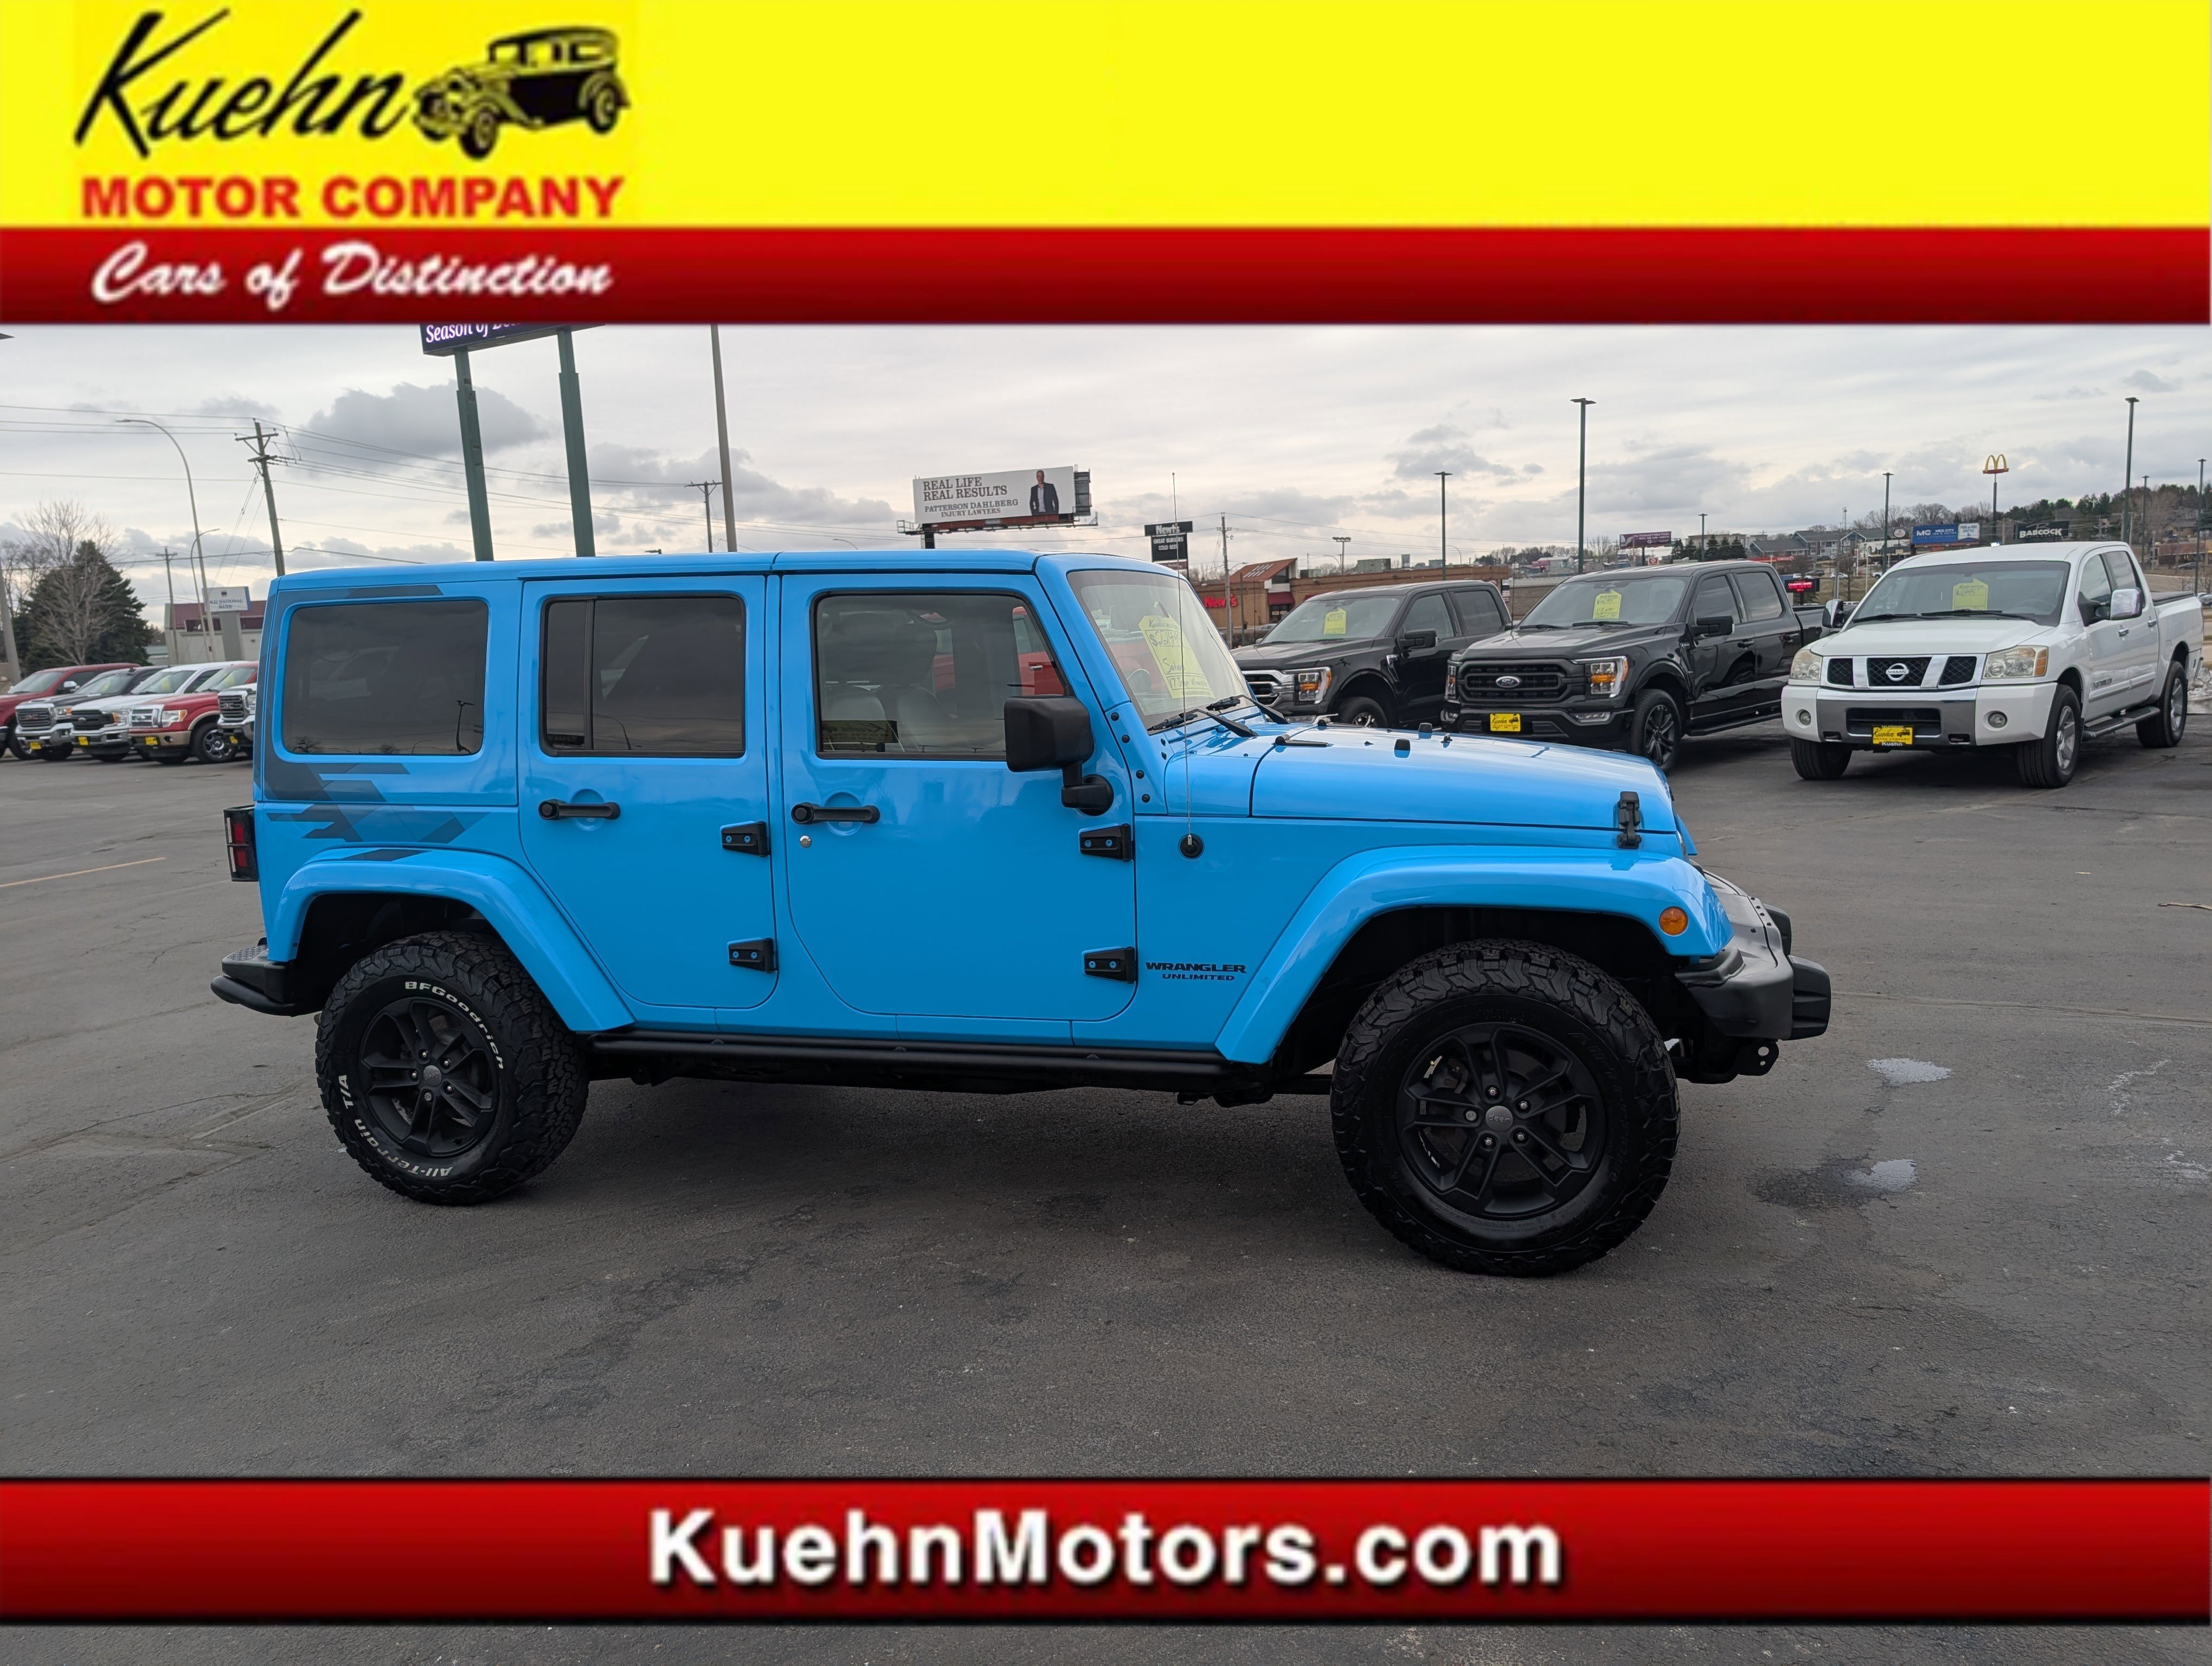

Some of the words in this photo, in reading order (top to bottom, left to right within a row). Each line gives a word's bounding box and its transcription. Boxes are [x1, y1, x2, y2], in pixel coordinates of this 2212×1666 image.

[426, 323, 473, 343] Season
[923, 479, 953, 491] REAL
[955, 477, 982, 488] LIFE
[923, 490, 954, 501] REAL
[956, 485, 1007, 498] RESULTS
[924, 503, 968, 512] PATTERSON
[970, 499, 1019, 509] DAHLBERG
[968, 508, 1001, 516] LAWYERS
[2019, 528, 2062, 539] BABCOCK
[1204, 593, 1237, 608] New's
[1145, 962, 1247, 974] WRANGLER
[404, 981, 504, 1070] BFGoodrich
[338, 1074, 355, 1110] T/A
[353, 1118, 455, 1178] All-Terrain
